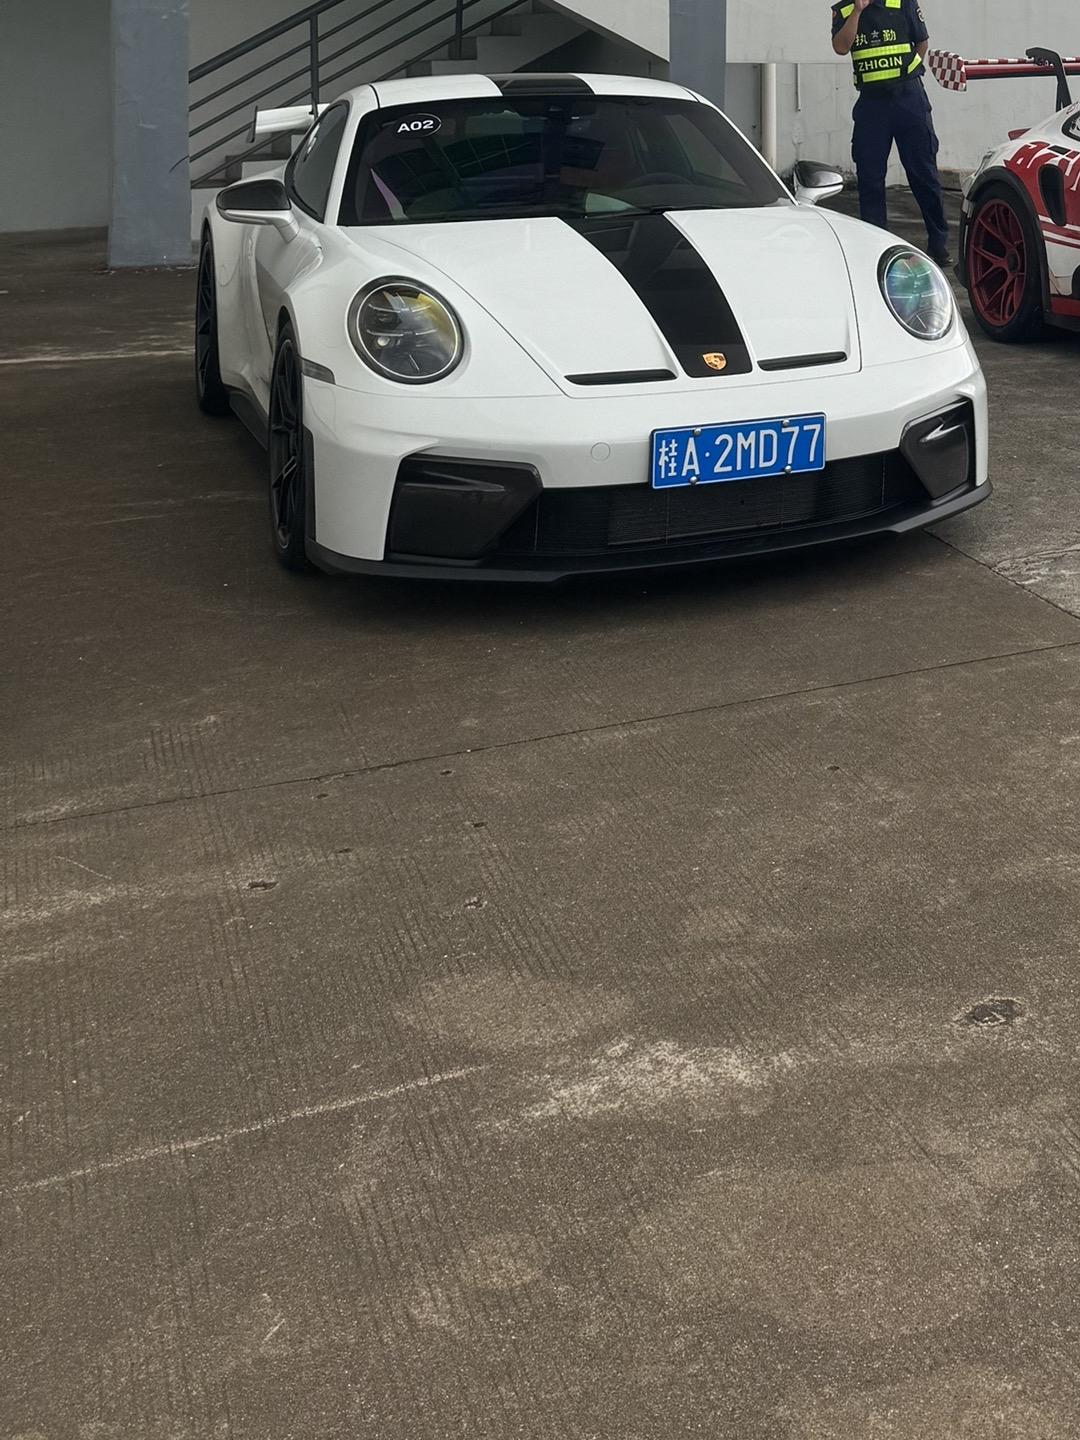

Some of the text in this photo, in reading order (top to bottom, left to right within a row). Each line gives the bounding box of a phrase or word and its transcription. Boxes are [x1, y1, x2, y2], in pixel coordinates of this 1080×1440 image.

[856, 29, 897, 46] 执勤
[859, 56, 903, 72] ZHIQIN
[397, 120, 434, 133] A02
